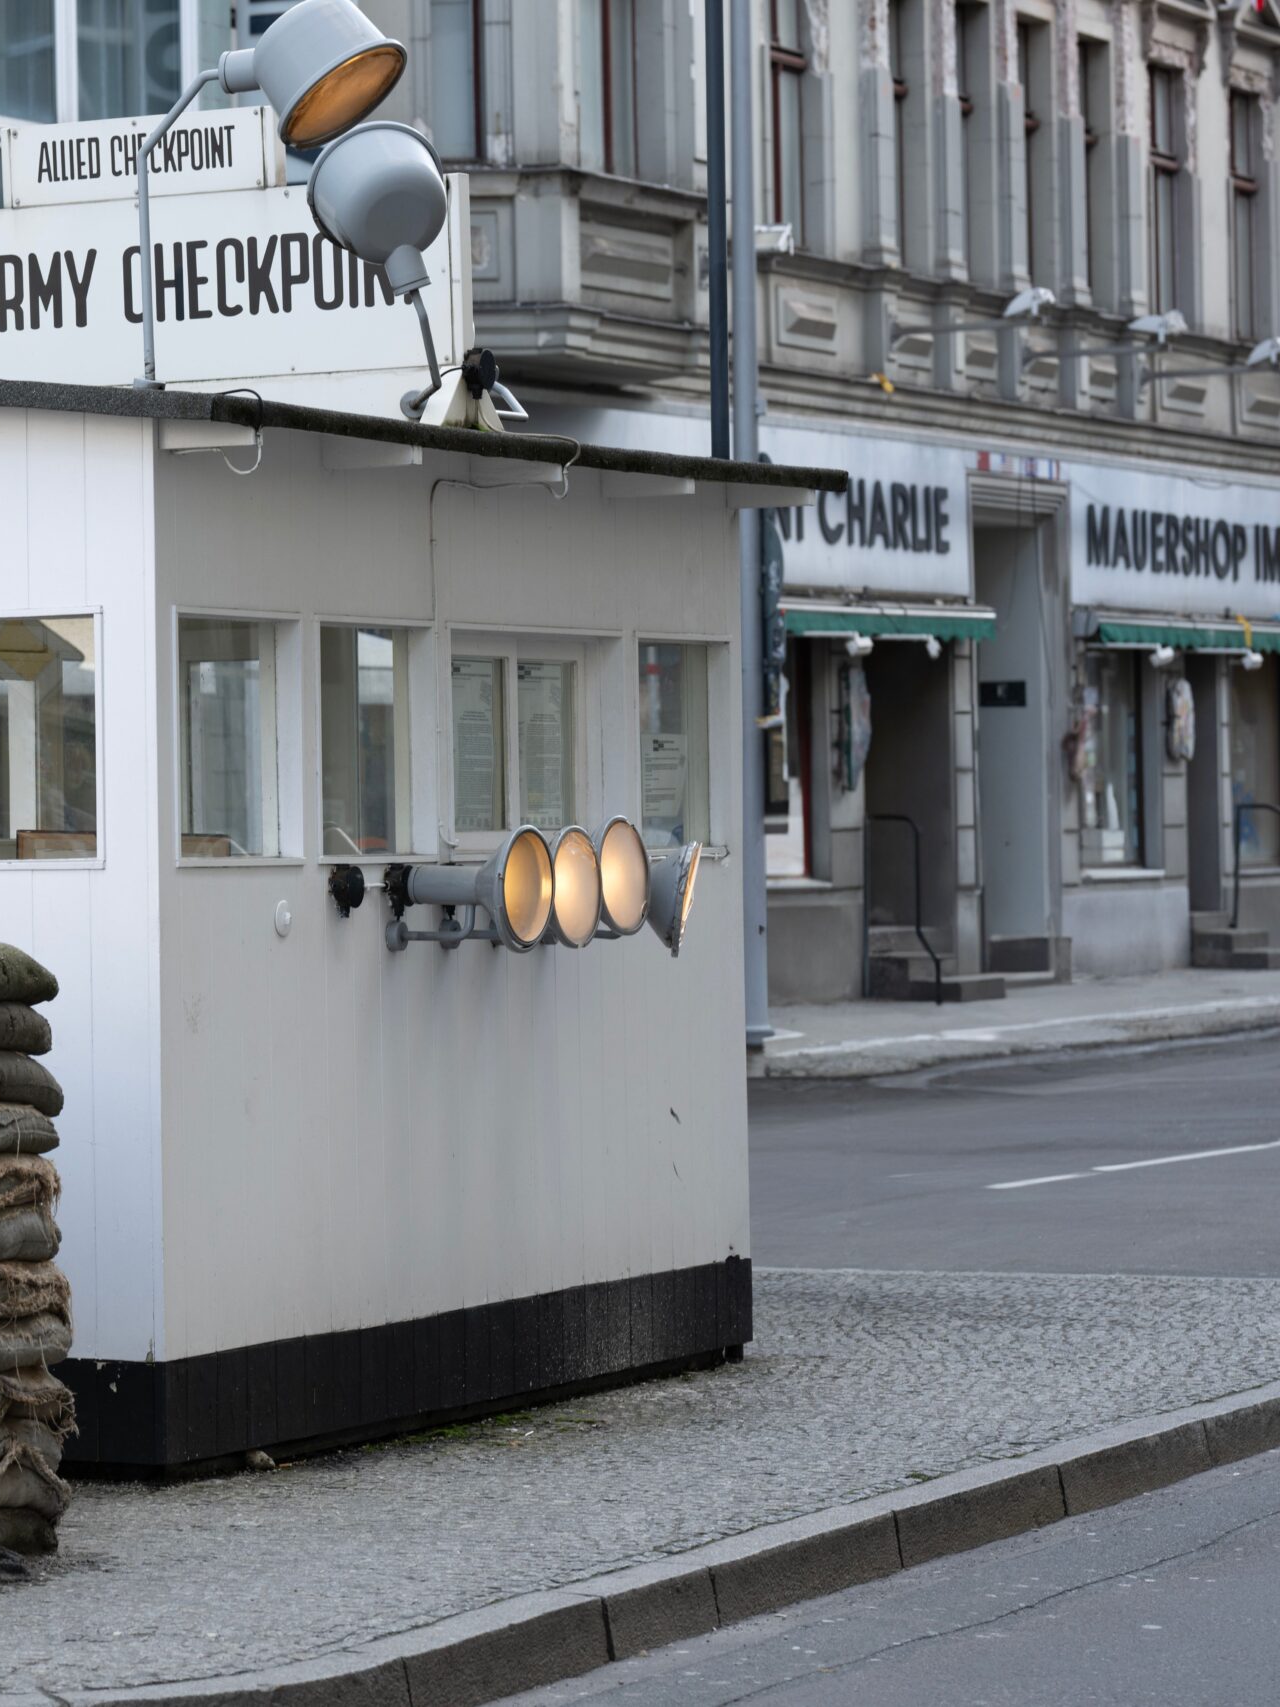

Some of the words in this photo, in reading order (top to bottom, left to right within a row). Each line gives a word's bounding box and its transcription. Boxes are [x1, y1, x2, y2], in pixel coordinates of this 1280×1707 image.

[38, 136, 100, 184] ALLIED
[123, 231, 415, 324] CHECKPOIN
[818, 479, 950, 554] CHARLIE
[1086, 504, 1247, 582] MAUERSHOP
